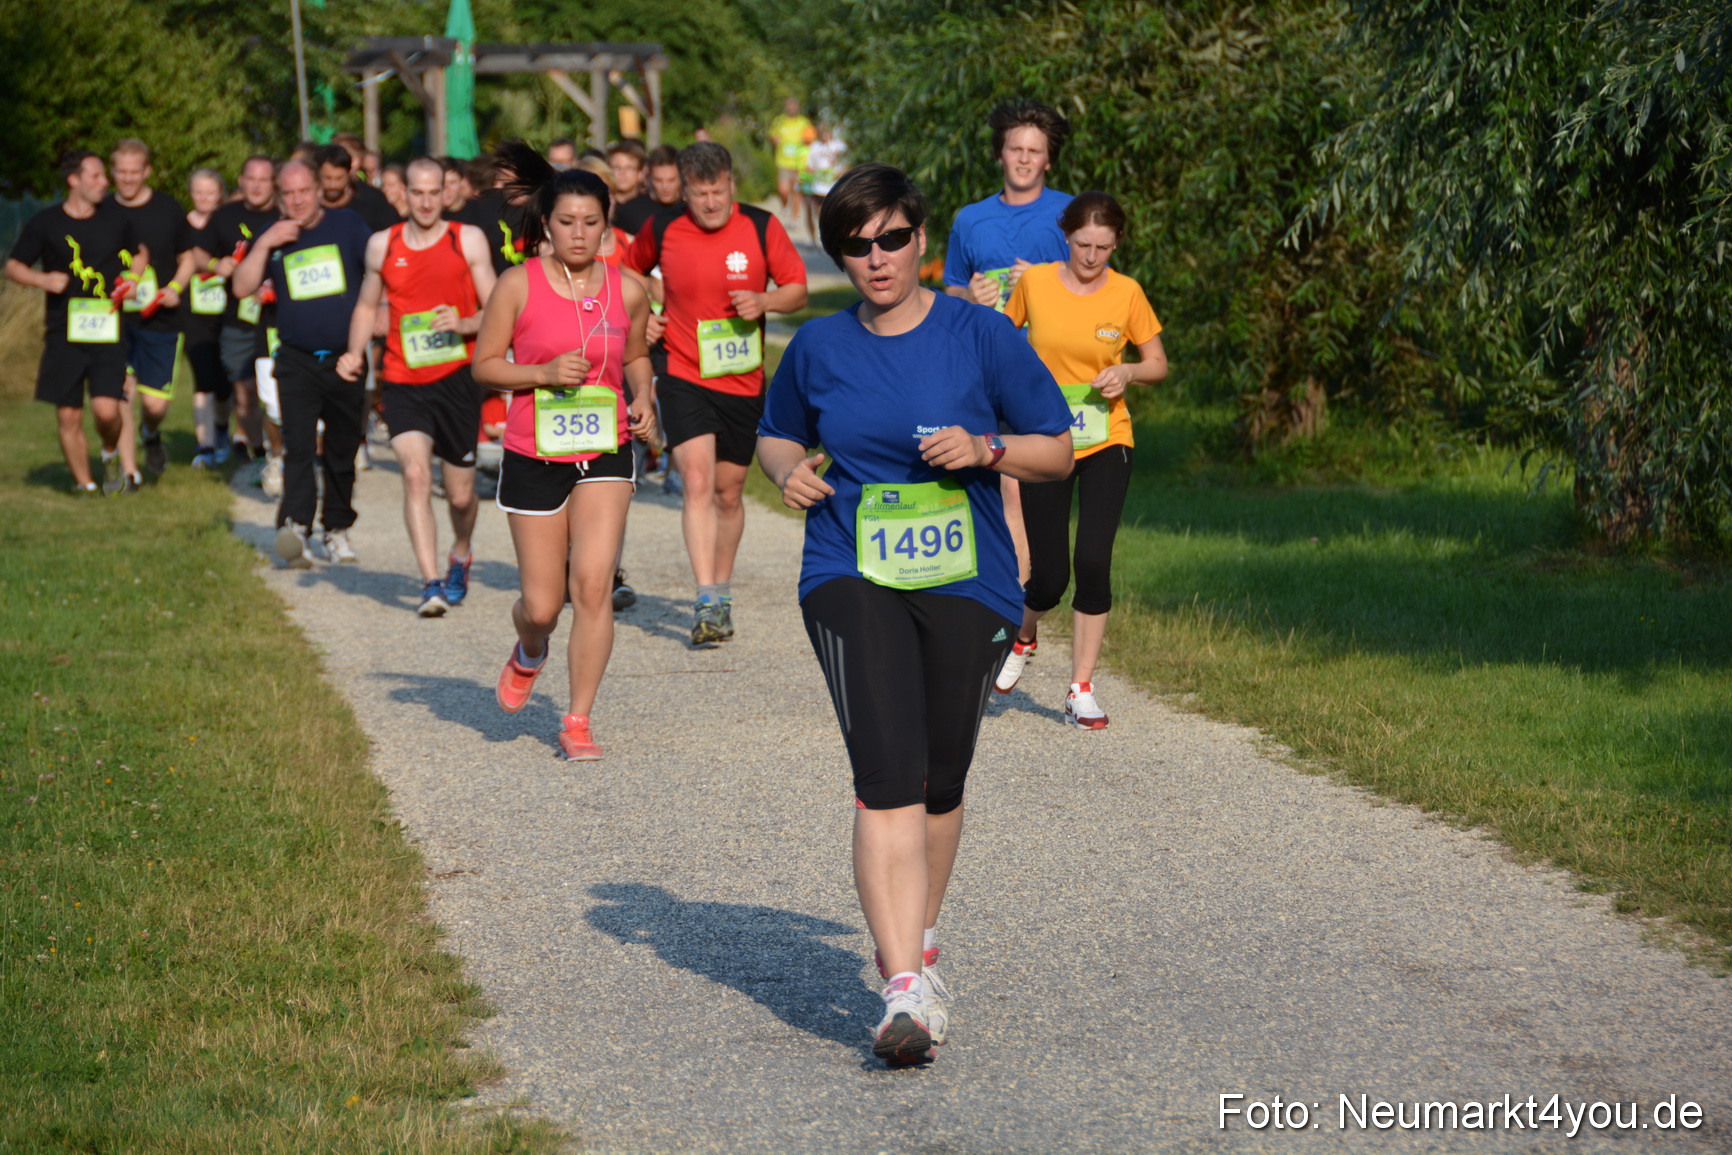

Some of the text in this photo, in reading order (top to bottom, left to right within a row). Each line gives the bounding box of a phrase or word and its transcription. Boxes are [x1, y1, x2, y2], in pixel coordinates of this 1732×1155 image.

[297, 265, 331, 285] 204
[79, 315, 106, 329] 247
[713, 338, 750, 361] 194
[552, 413, 600, 436] 358
[916, 425, 940, 435] Sport
[873, 501, 917, 511] firmenlauf
[870, 519, 964, 561] 1496
[898, 564, 942, 575] Doris Holler
